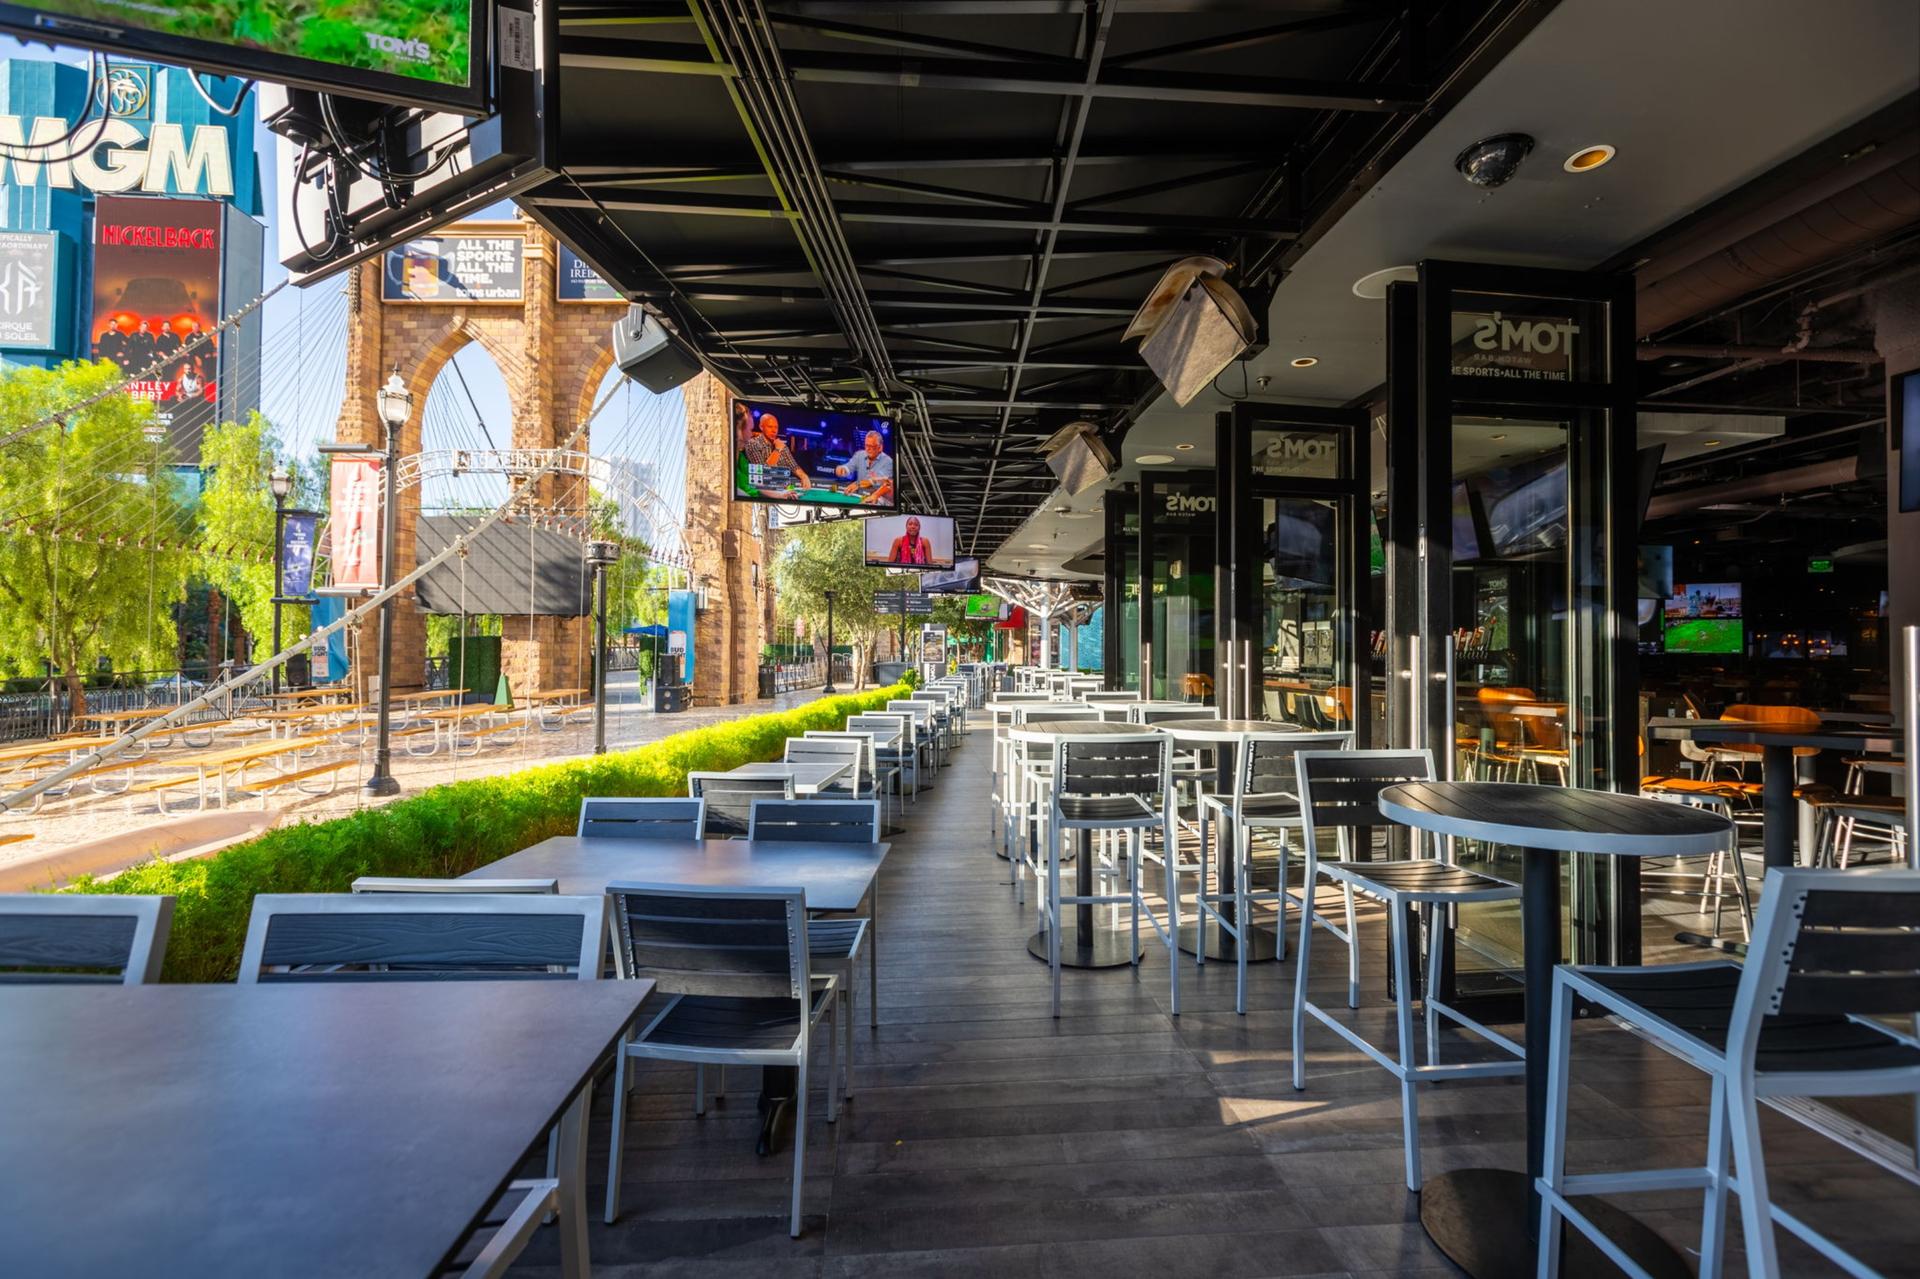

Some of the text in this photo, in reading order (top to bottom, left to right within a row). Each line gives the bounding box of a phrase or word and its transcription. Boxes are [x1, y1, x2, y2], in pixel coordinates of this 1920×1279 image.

[364, 32, 430, 60] TOM'S
[0, 114, 234, 196] MGM
[102, 224, 215, 249] NICKELBACK
[457, 239, 514, 251] ALL THE
[456, 262, 514, 273] ALL THE
[570, 268, 601, 278] IRELA
[485, 286, 520, 298] urban
[1523, 370, 1541, 379] THE
[1543, 371, 1566, 381] TIME
